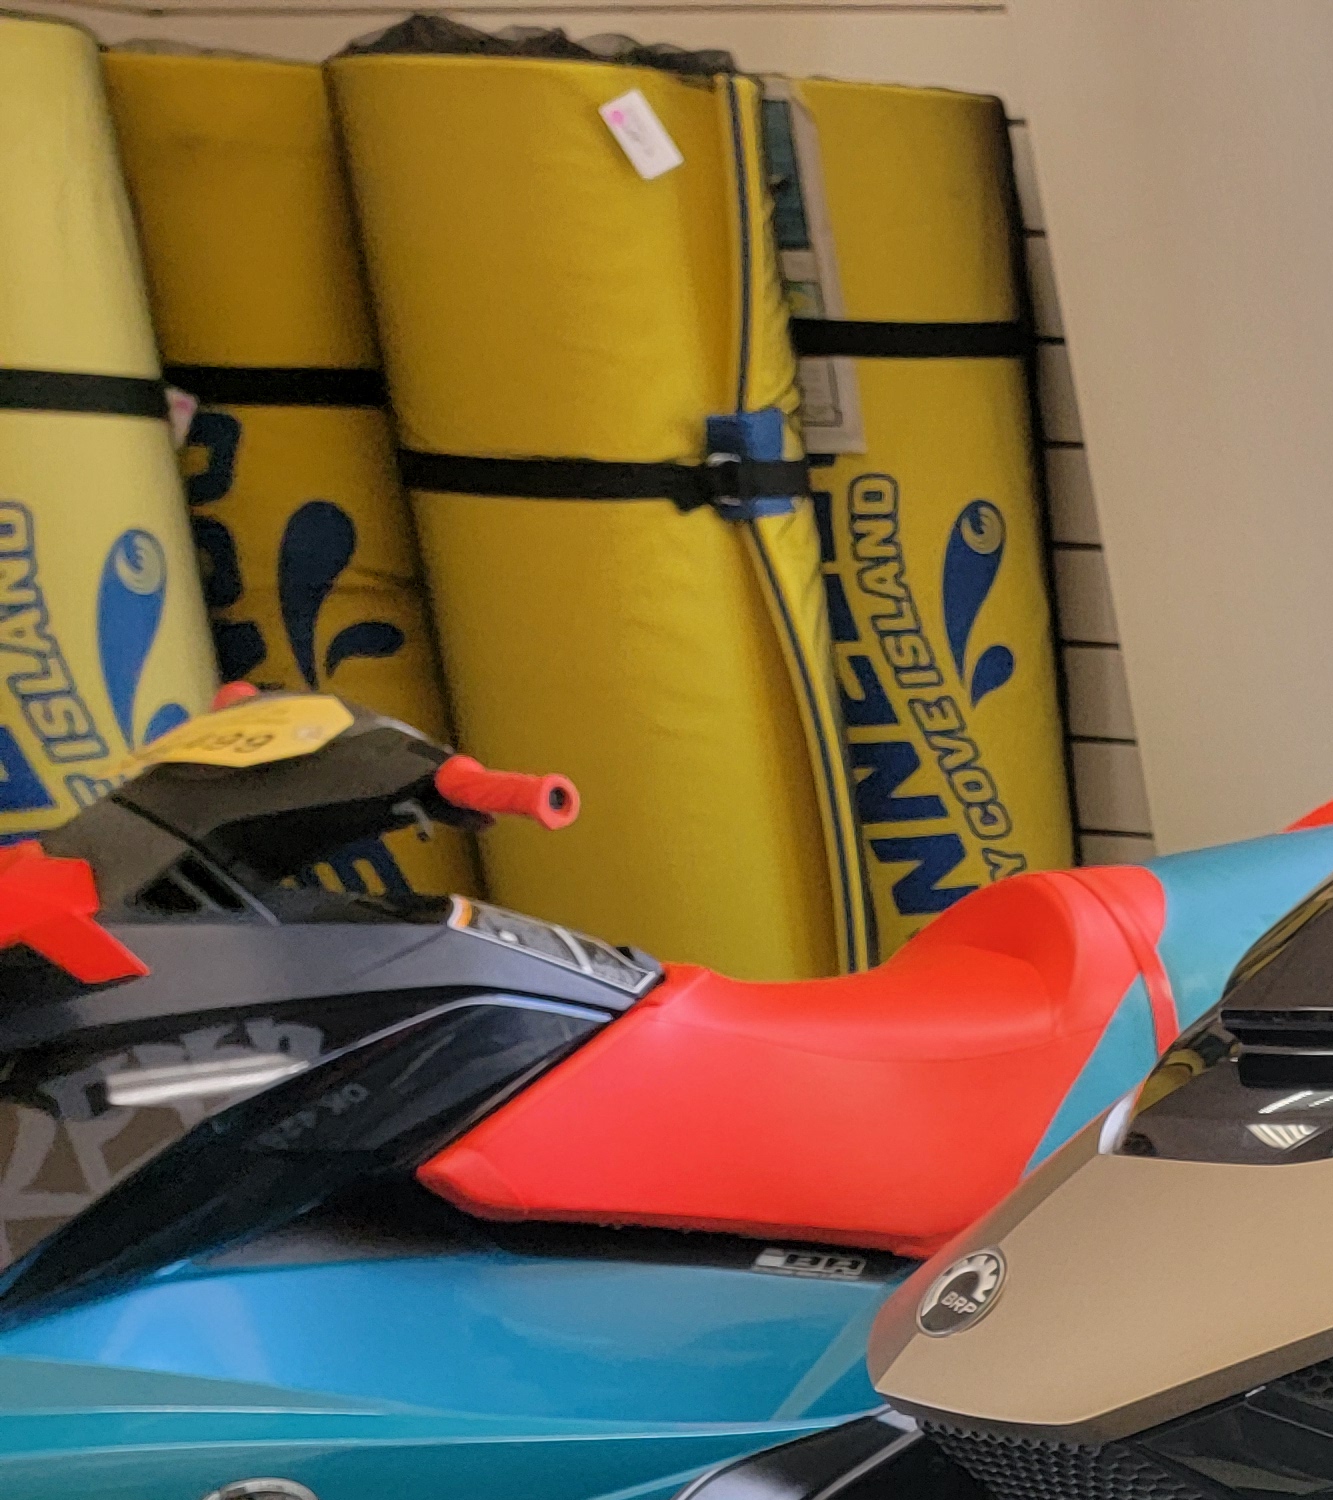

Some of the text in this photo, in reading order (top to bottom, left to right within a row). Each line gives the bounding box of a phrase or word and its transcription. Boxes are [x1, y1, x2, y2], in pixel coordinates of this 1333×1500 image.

[847, 472, 944, 690] ISLAND
[909, 694, 1013, 841] COVE
[940, 1290, 978, 1315] BRP
